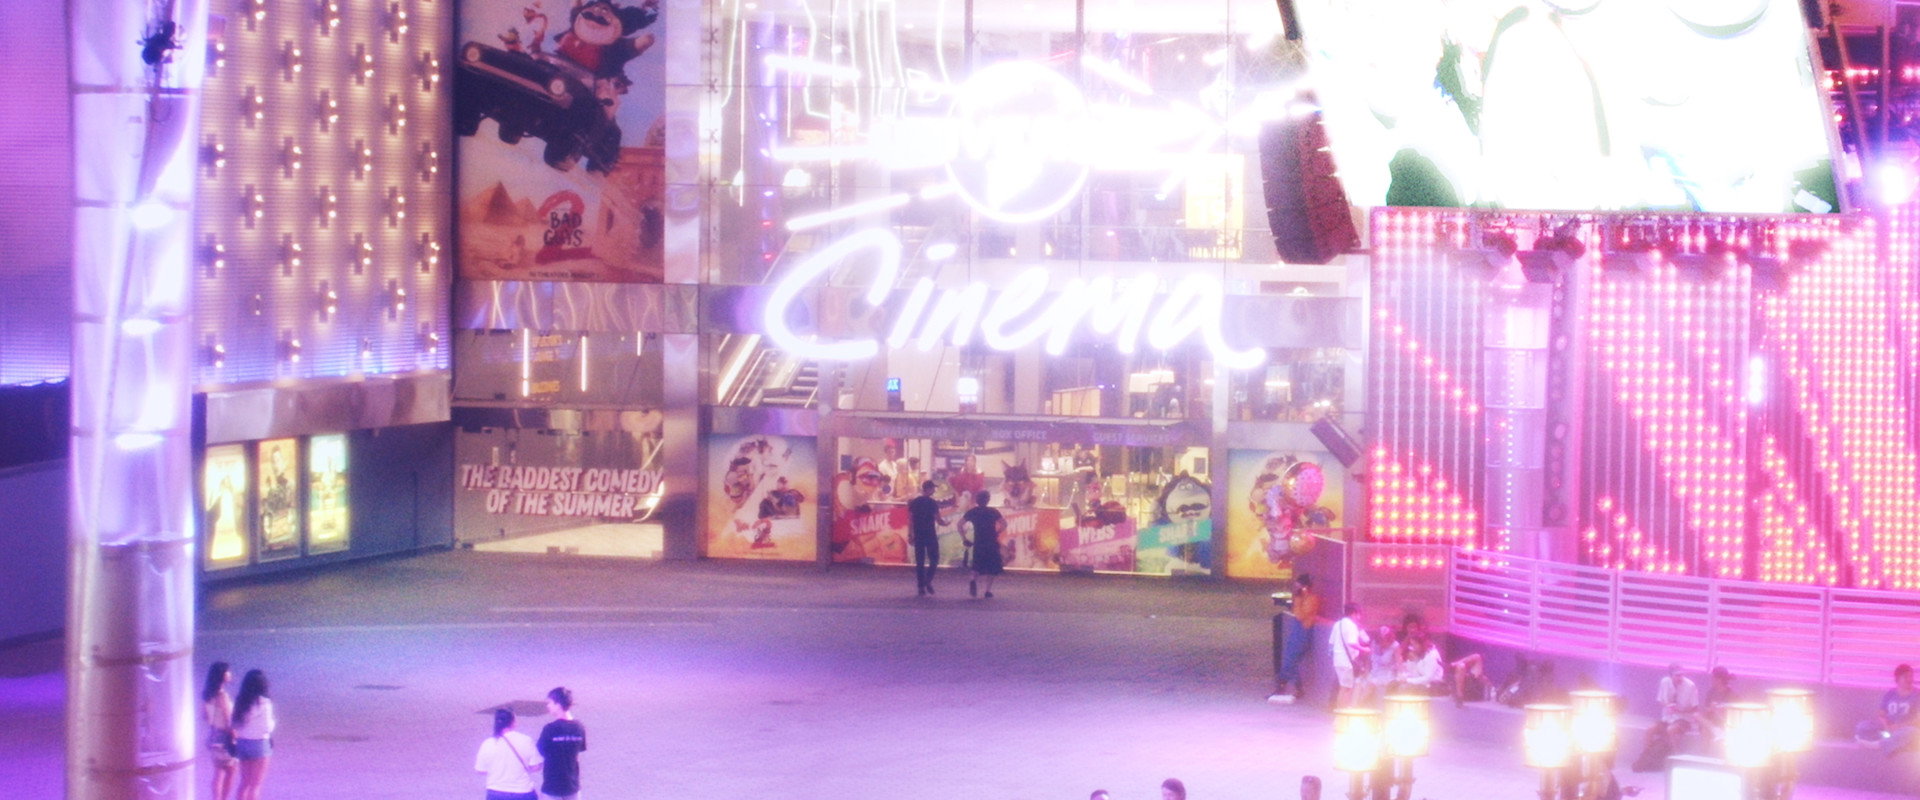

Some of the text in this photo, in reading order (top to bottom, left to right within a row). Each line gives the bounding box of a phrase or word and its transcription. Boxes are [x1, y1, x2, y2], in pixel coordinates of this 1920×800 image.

[550, 212, 582, 229] BAD
[764, 227, 1266, 370] Cinema
[916, 427, 949, 438] ENTRY
[992, 430, 1012, 440] BOX
[1014, 430, 1047, 441] OFFICE
[1093, 432, 1123, 443] GUEST
[461, 464, 662, 493] THE BADDEST COMEDY
[486, 489, 636, 518] OF THE SUMMER
[849, 511, 892, 536] SNAKE
[1006, 513, 1038, 535] WOLF
[1078, 523, 1116, 545] WEBS
